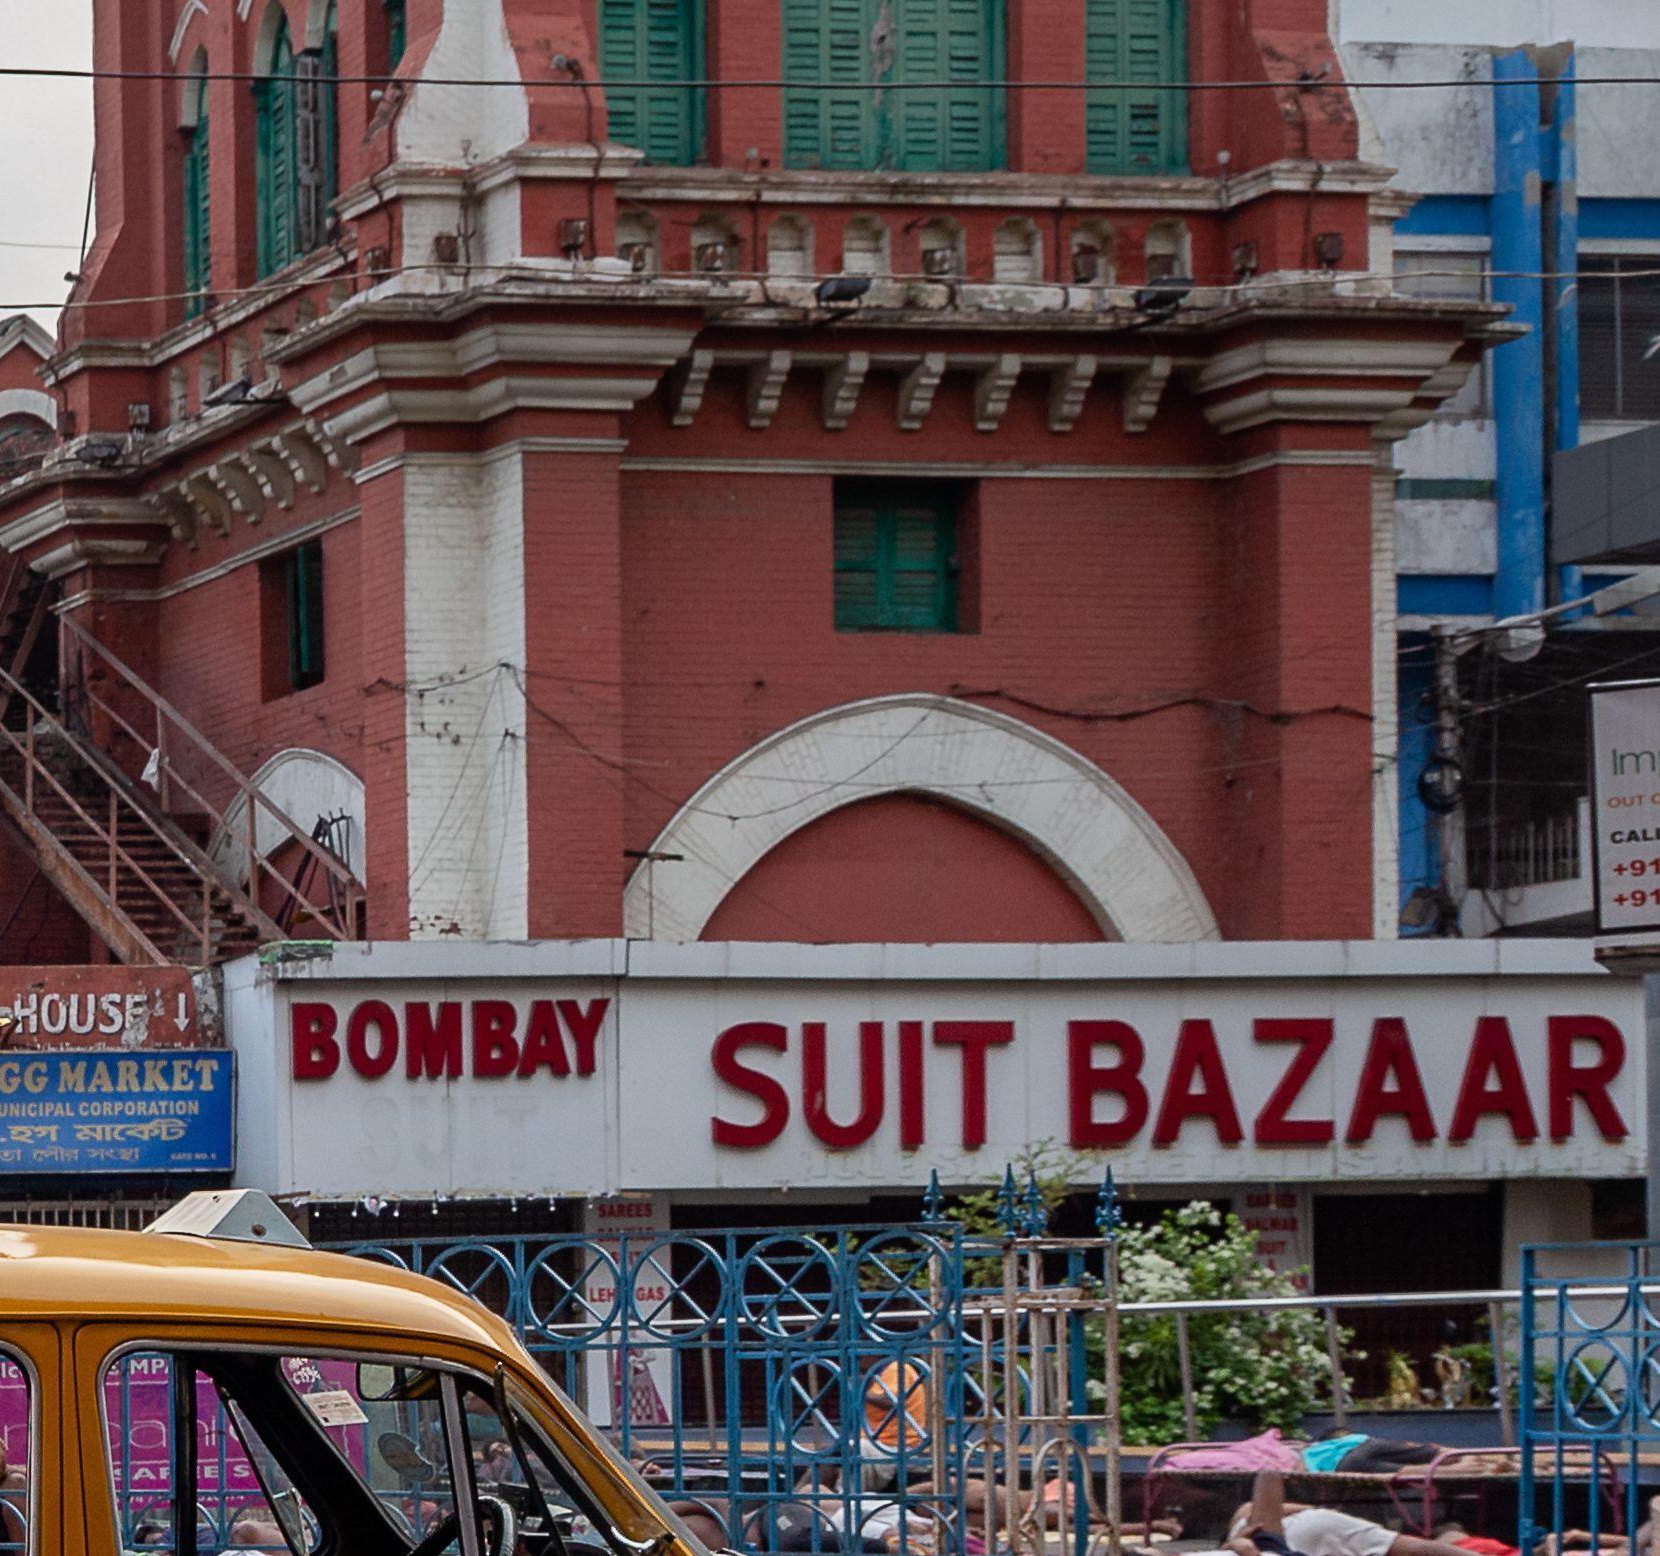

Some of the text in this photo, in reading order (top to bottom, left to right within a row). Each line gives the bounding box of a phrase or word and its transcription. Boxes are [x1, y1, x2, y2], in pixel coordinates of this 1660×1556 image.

[1607, 794, 1643, 808] OUT
[292, 998, 611, 1080] BOMBAY
[58, 1059, 219, 1093] MARKET
[710, 1013, 1630, 1151] SUIT BAZAAR
[79, 1099, 199, 1116] CORPORATION
[598, 1203, 653, 1218] SAREES
